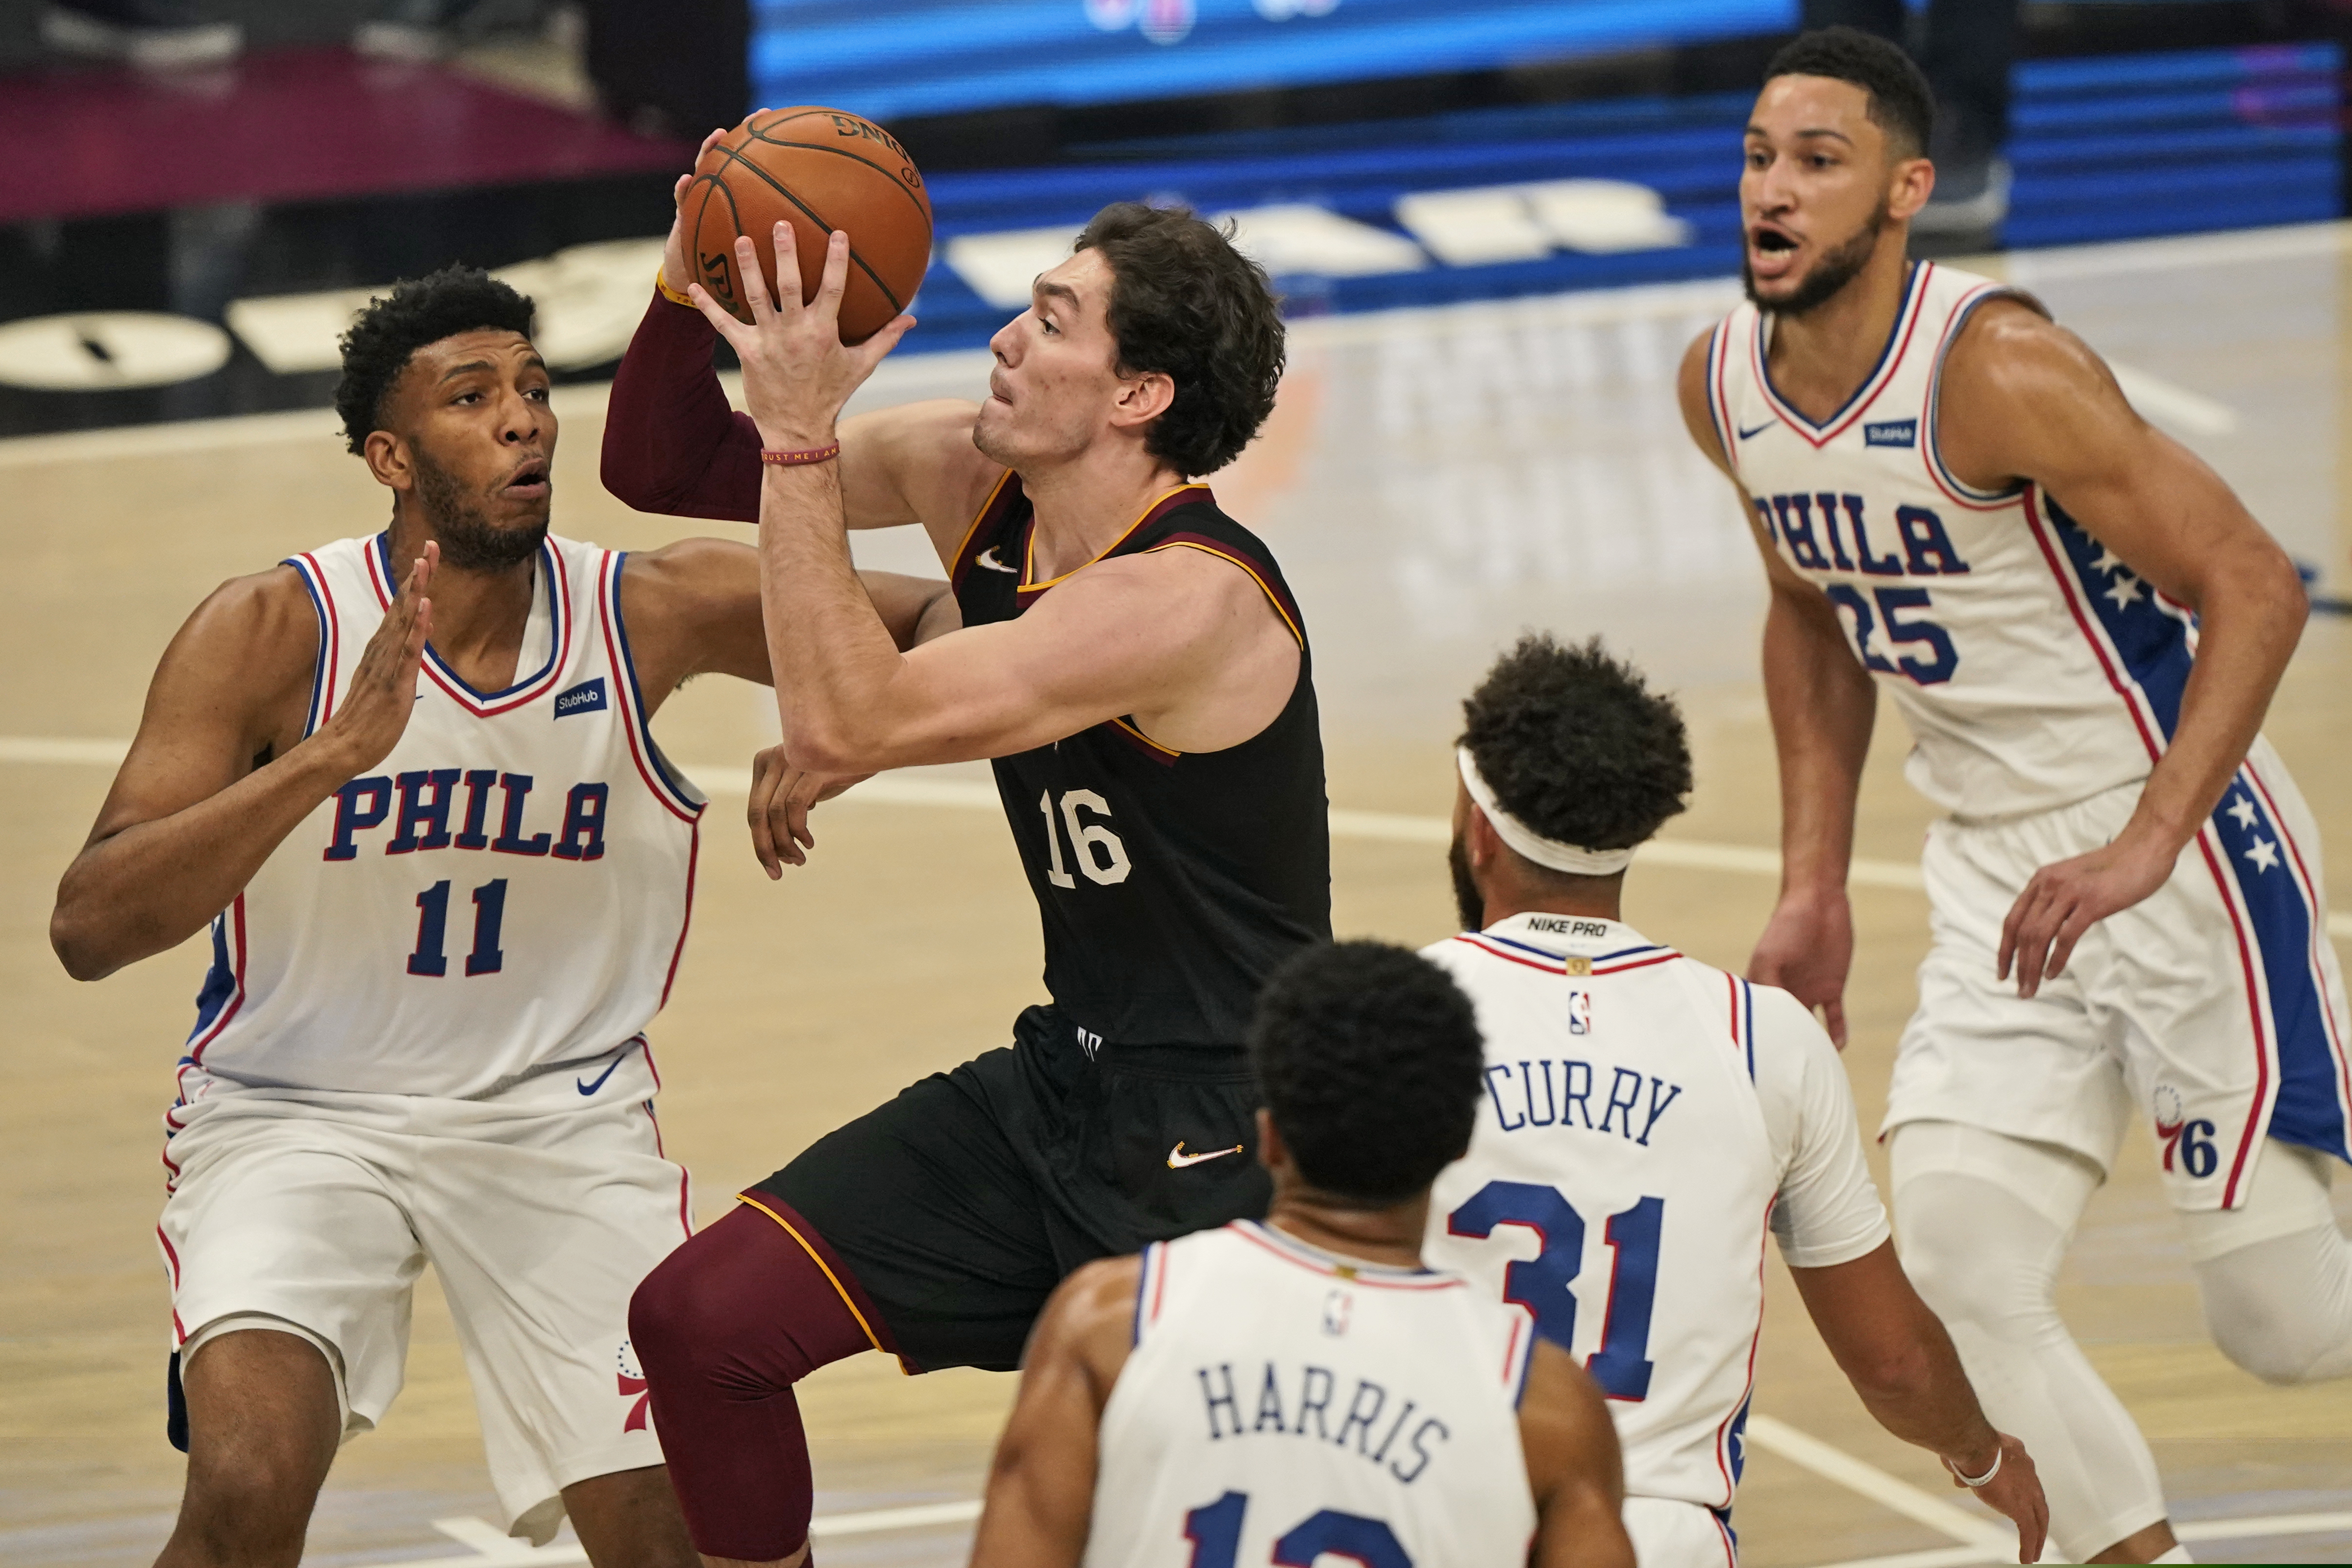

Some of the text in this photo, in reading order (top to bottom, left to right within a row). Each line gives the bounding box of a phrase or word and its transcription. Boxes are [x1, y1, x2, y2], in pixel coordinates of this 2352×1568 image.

[1825, 583, 1959, 686] 25
[559, 689, 598, 710] StubHub
[323, 768, 609, 862] PHILA
[1040, 788, 1132, 889] 16
[407, 878, 508, 977] 11
[1527, 917, 1607, 936] NIKE PRO
[1485, 1059, 1682, 1147] CURRY
[1448, 1180, 1664, 1402] 31
[1198, 1362, 1450, 1484] HARRIS
